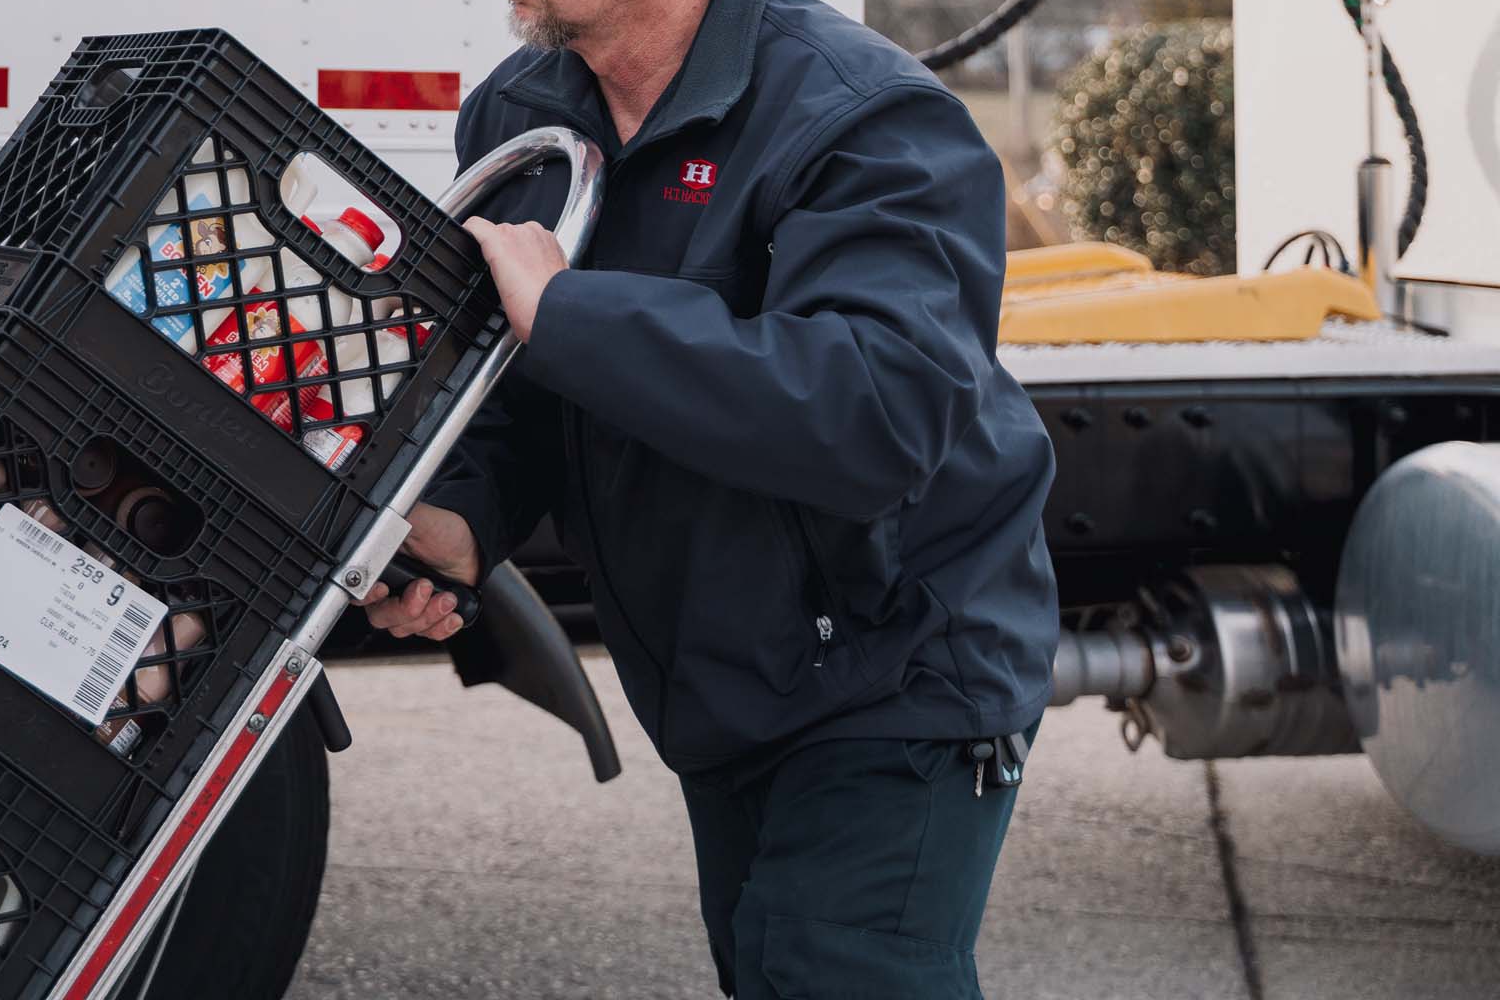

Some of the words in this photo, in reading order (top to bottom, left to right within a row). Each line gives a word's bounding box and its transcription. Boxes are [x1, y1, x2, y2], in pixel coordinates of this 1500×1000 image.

[682, 162, 713, 184] H
[69, 557, 106, 586] 258
[105, 583, 126, 608] 9
